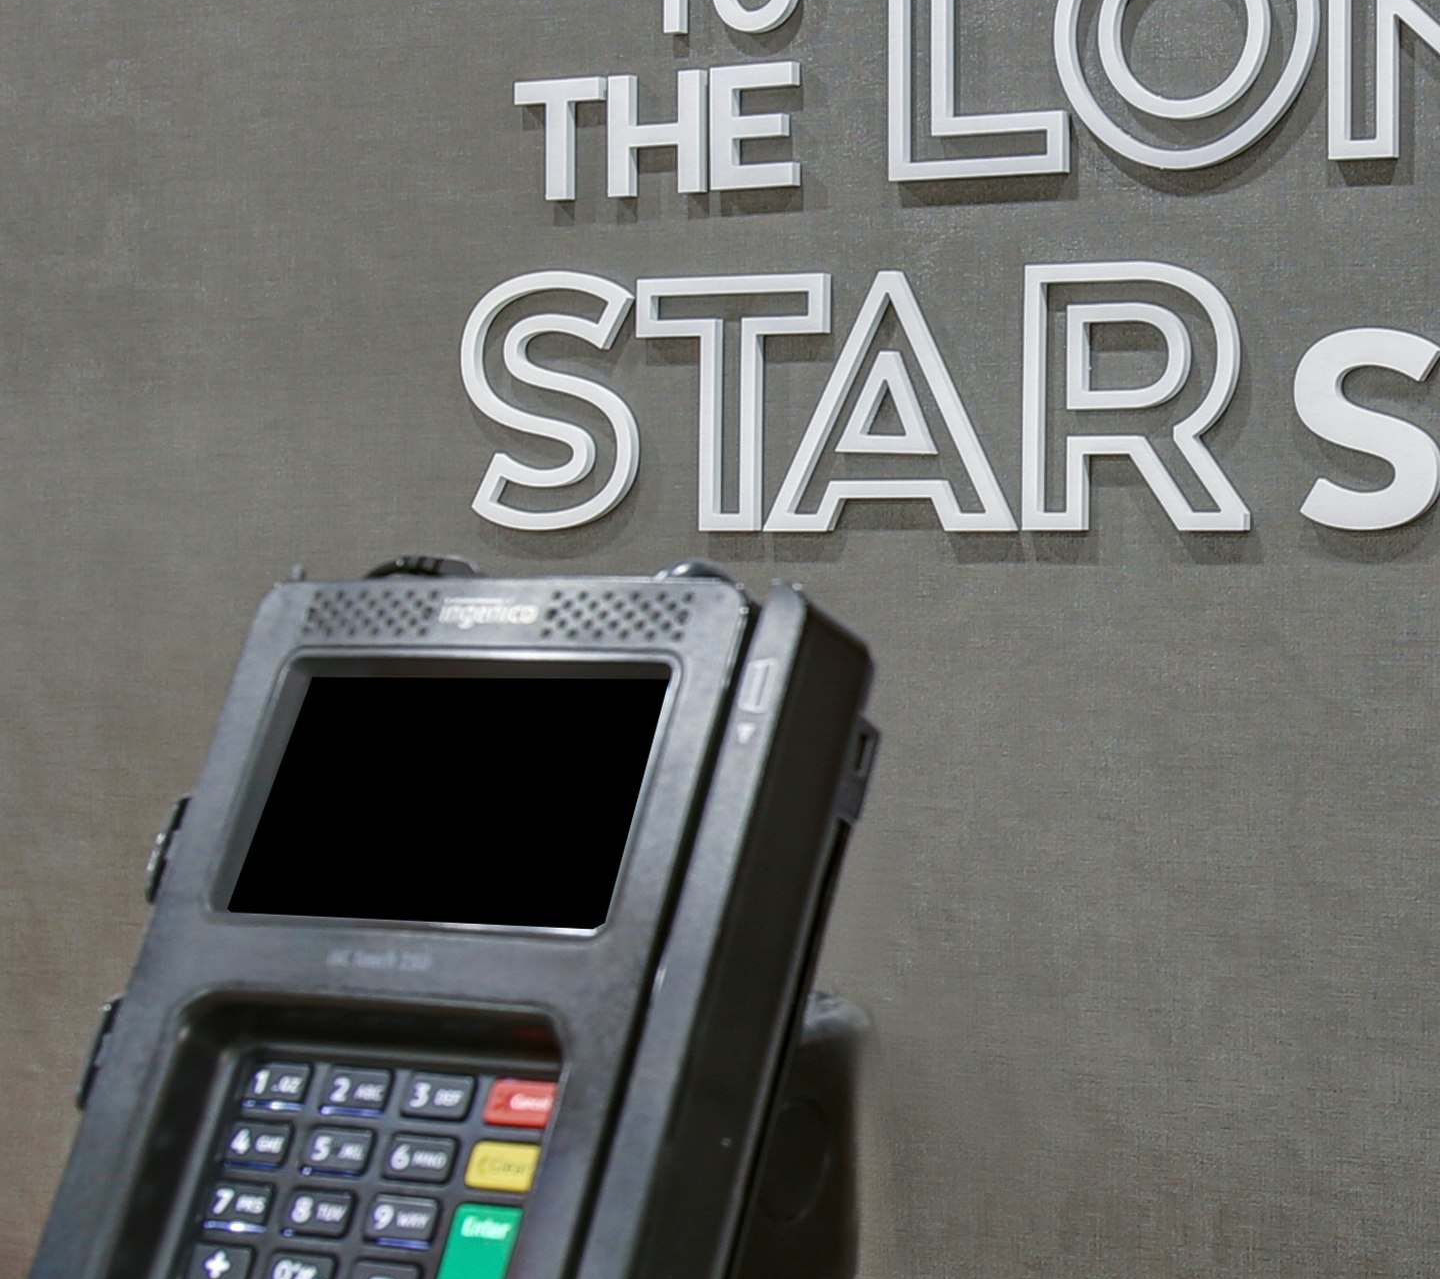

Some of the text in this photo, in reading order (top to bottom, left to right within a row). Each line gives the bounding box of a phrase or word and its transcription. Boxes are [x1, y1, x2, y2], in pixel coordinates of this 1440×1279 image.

[512, 61, 801, 202] THE
[461, 261, 1253, 534] STAR
[253, 1069, 270, 1095] 1
[329, 1076, 351, 1103] 2
[409, 1082, 431, 1108] 3
[230, 1128, 251, 1155] 4
[311, 1135, 333, 1161] 5
[389, 1143, 410, 1170] 6
[212, 1187, 235, 1215] 7
[290, 1196, 314, 1223] 8
[373, 1204, 395, 1231] 9
[461, 1215, 512, 1240] Enter
